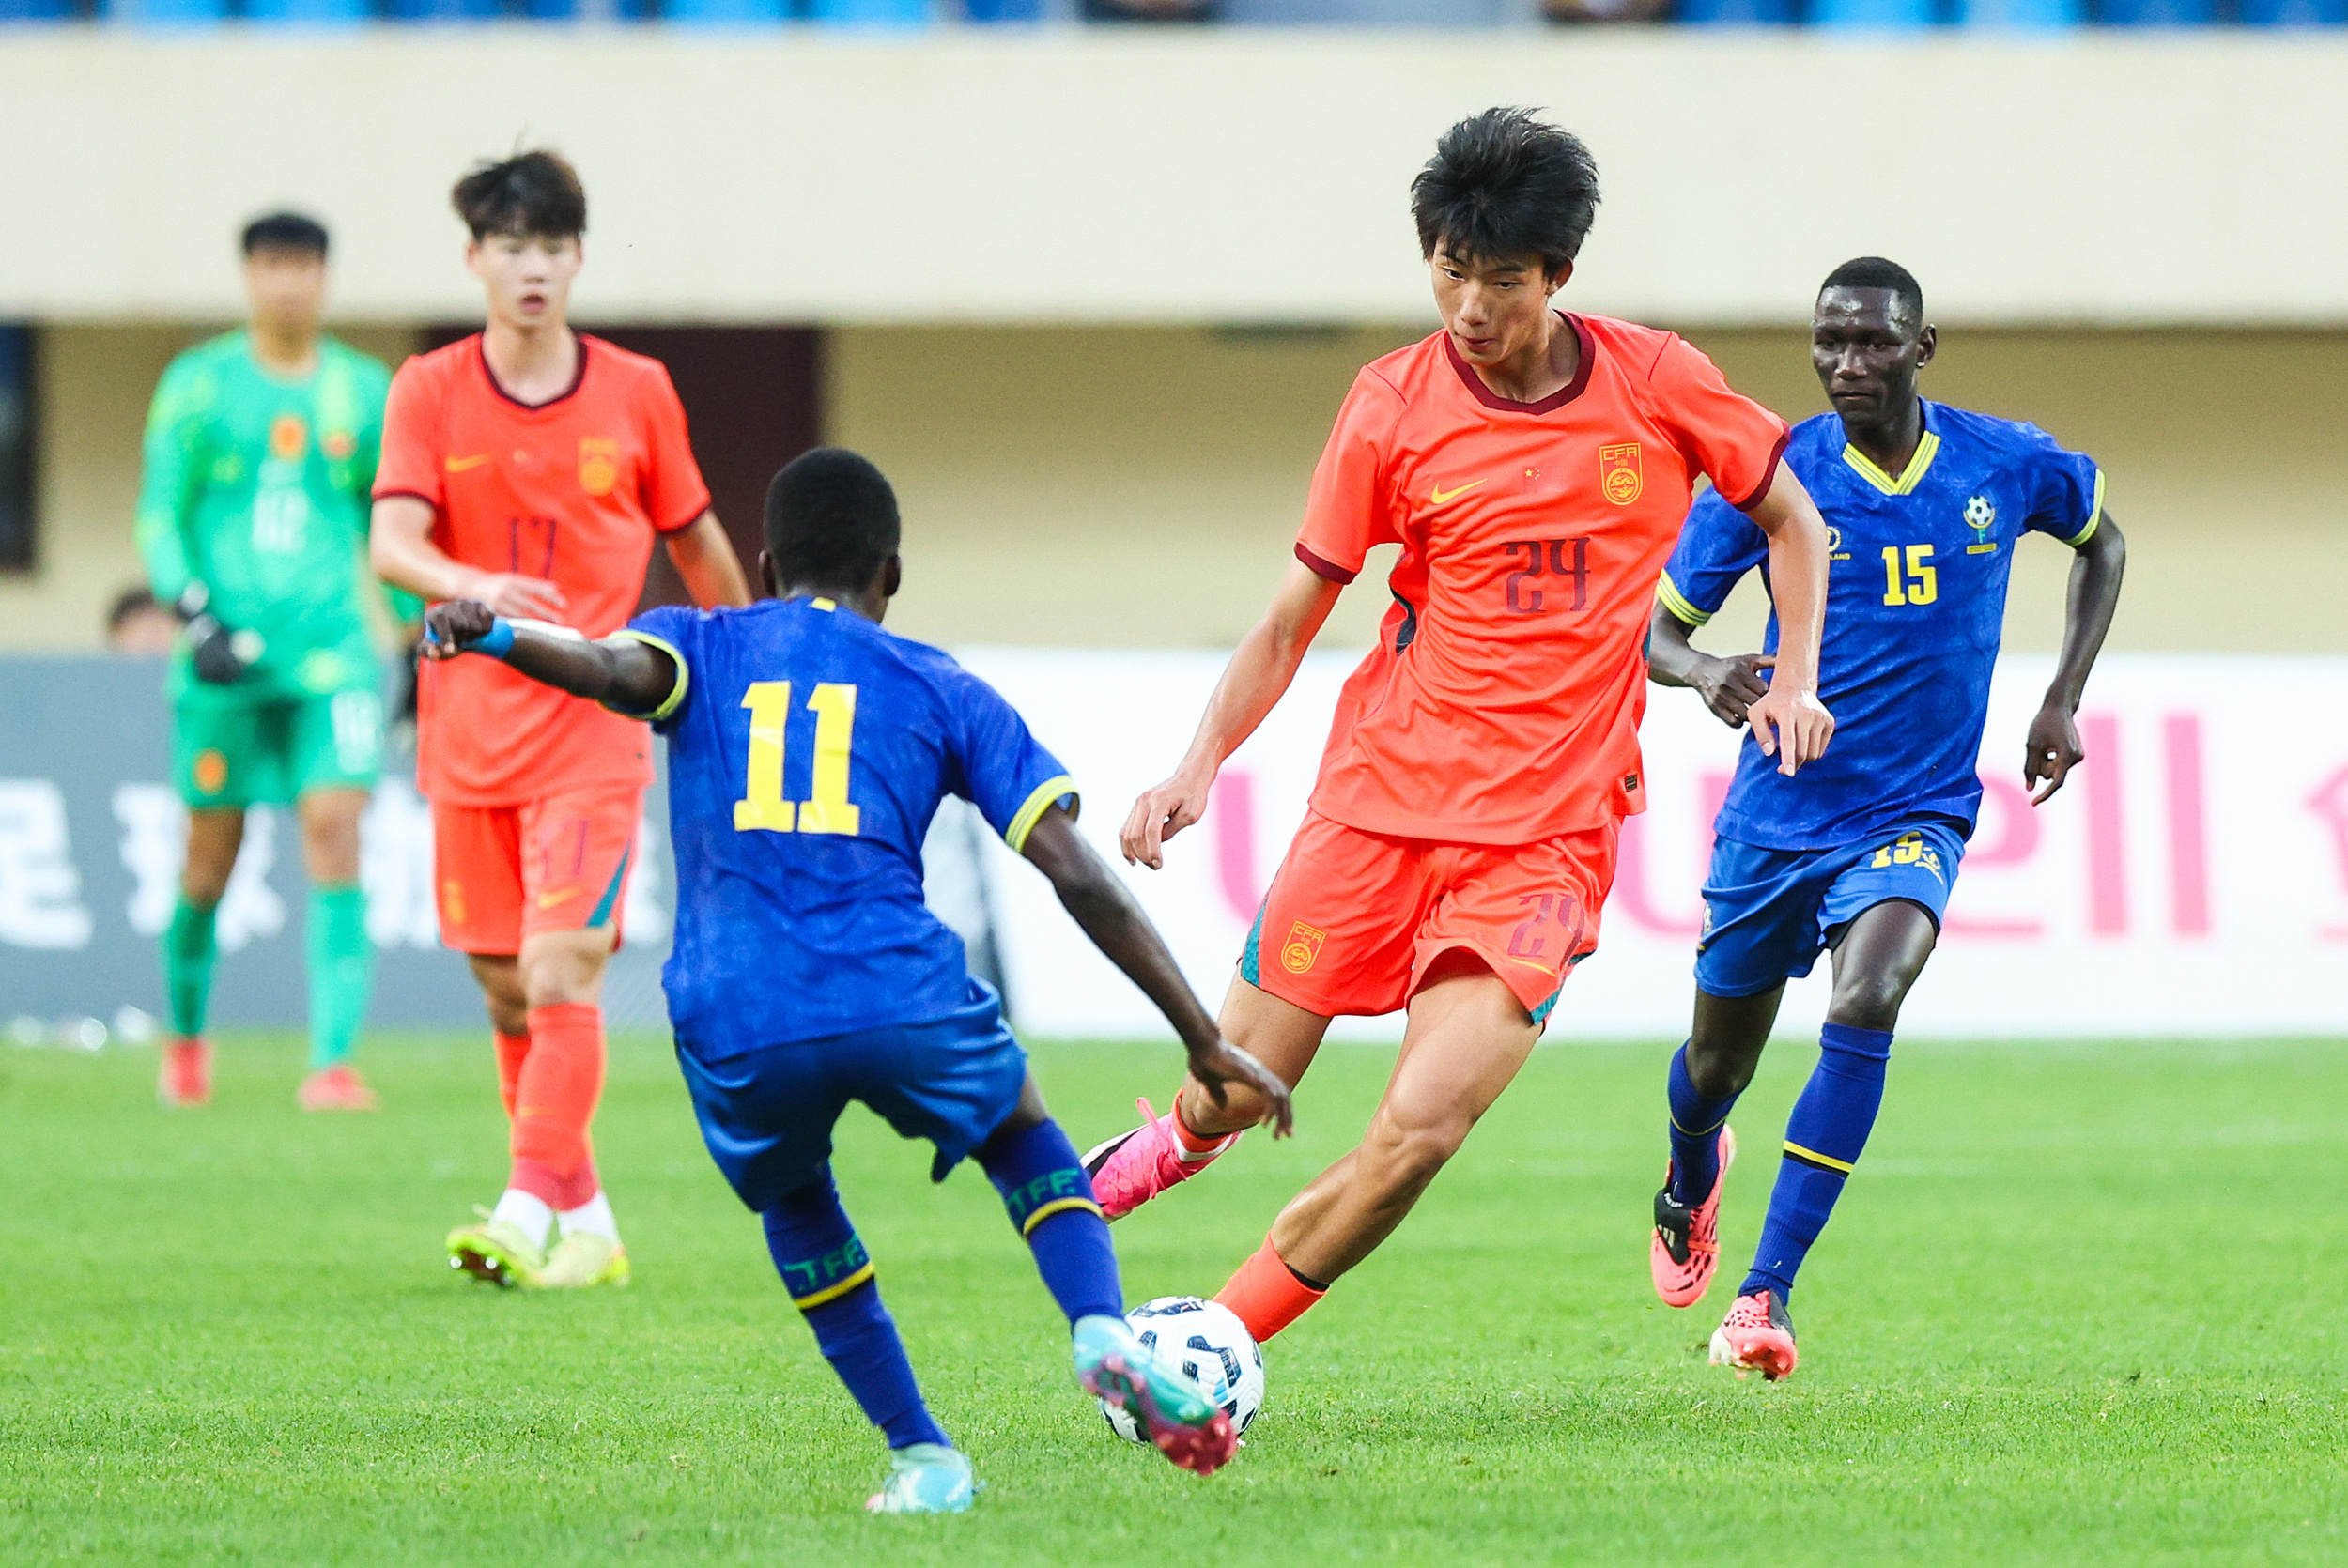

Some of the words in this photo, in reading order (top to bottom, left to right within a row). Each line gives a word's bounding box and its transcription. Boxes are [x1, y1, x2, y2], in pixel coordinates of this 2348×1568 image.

[1602, 446, 1637, 460] CFA
[1504, 537, 1591, 614] 24
[1881, 543, 1938, 607] 15
[733, 680, 860, 837] 11
[1870, 830, 1923, 869] 15
[1294, 925, 1322, 944] CFA
